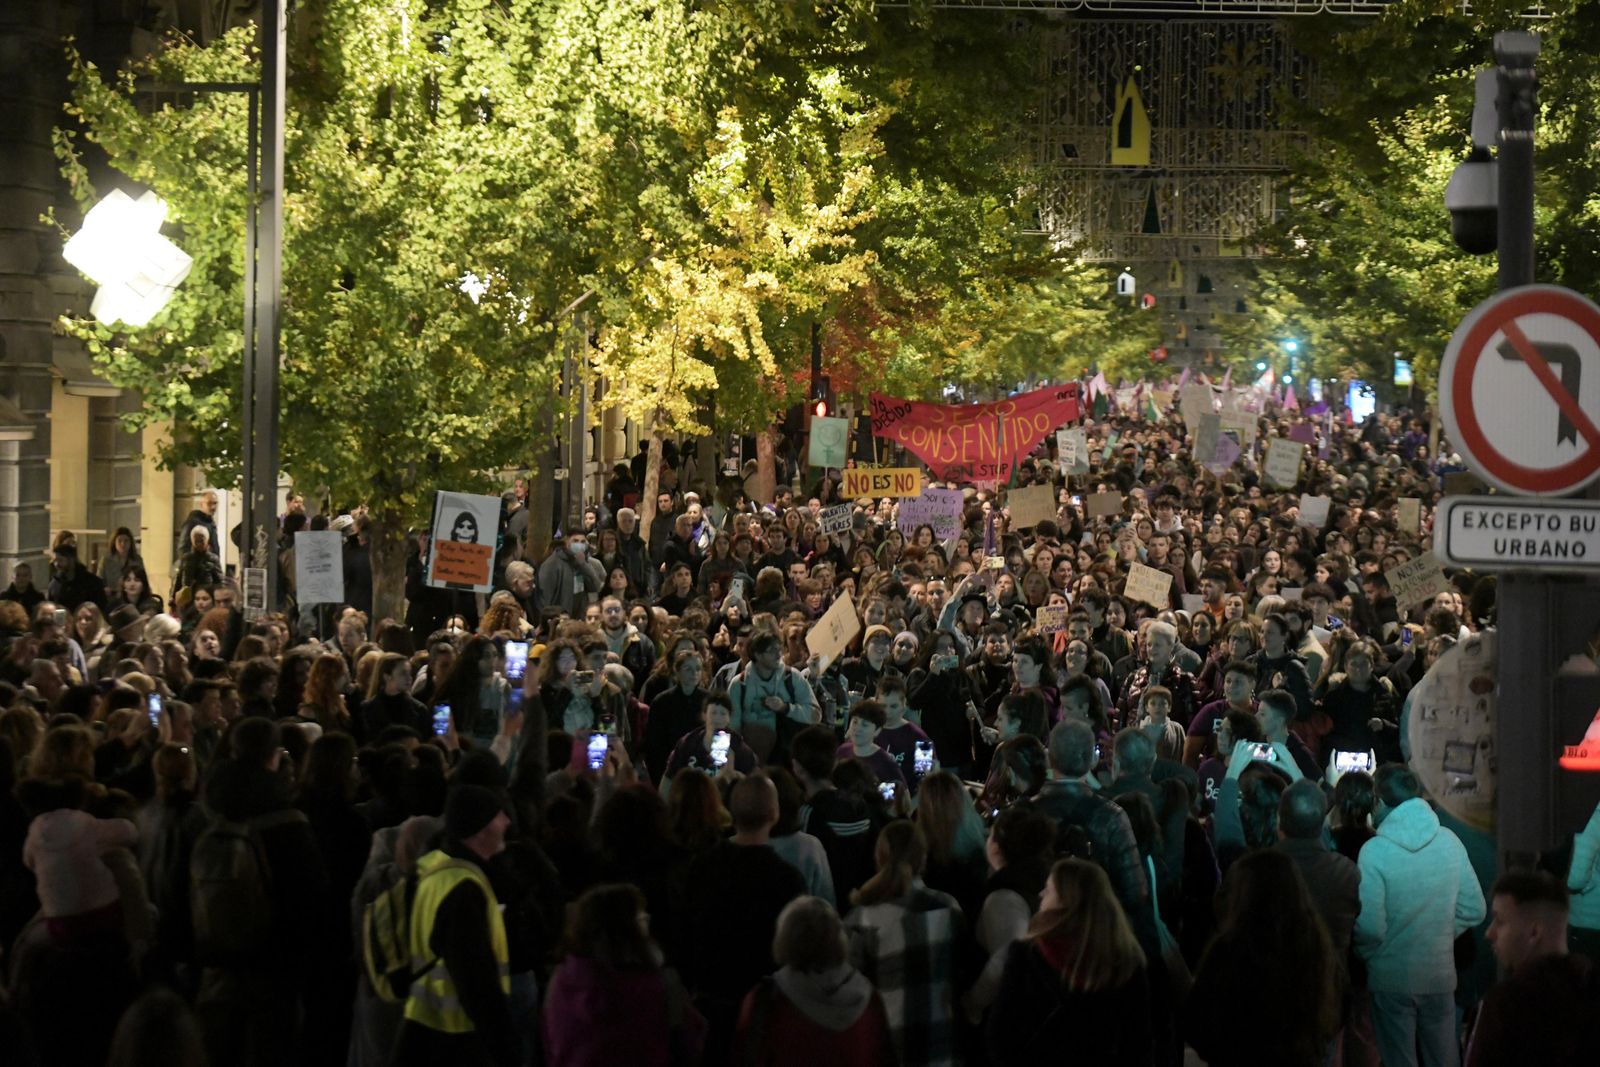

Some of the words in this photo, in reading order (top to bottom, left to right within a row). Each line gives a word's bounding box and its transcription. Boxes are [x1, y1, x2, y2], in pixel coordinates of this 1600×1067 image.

[871, 399, 885, 414] YO
[873, 403, 912, 431] DECIDO
[929, 402, 1016, 423] SEXO
[900, 413, 1050, 464] CONSENTIDO
[979, 464, 1008, 476] STOP
[847, 473, 870, 495] NO
[873, 475, 891, 490] ES
[895, 474, 914, 493] NO
[1463, 511, 1561, 531] EXCEPTO
[1570, 515, 1600, 532] BU
[1494, 538, 1586, 558] URBANO
[1397, 567, 1413, 580] NO
